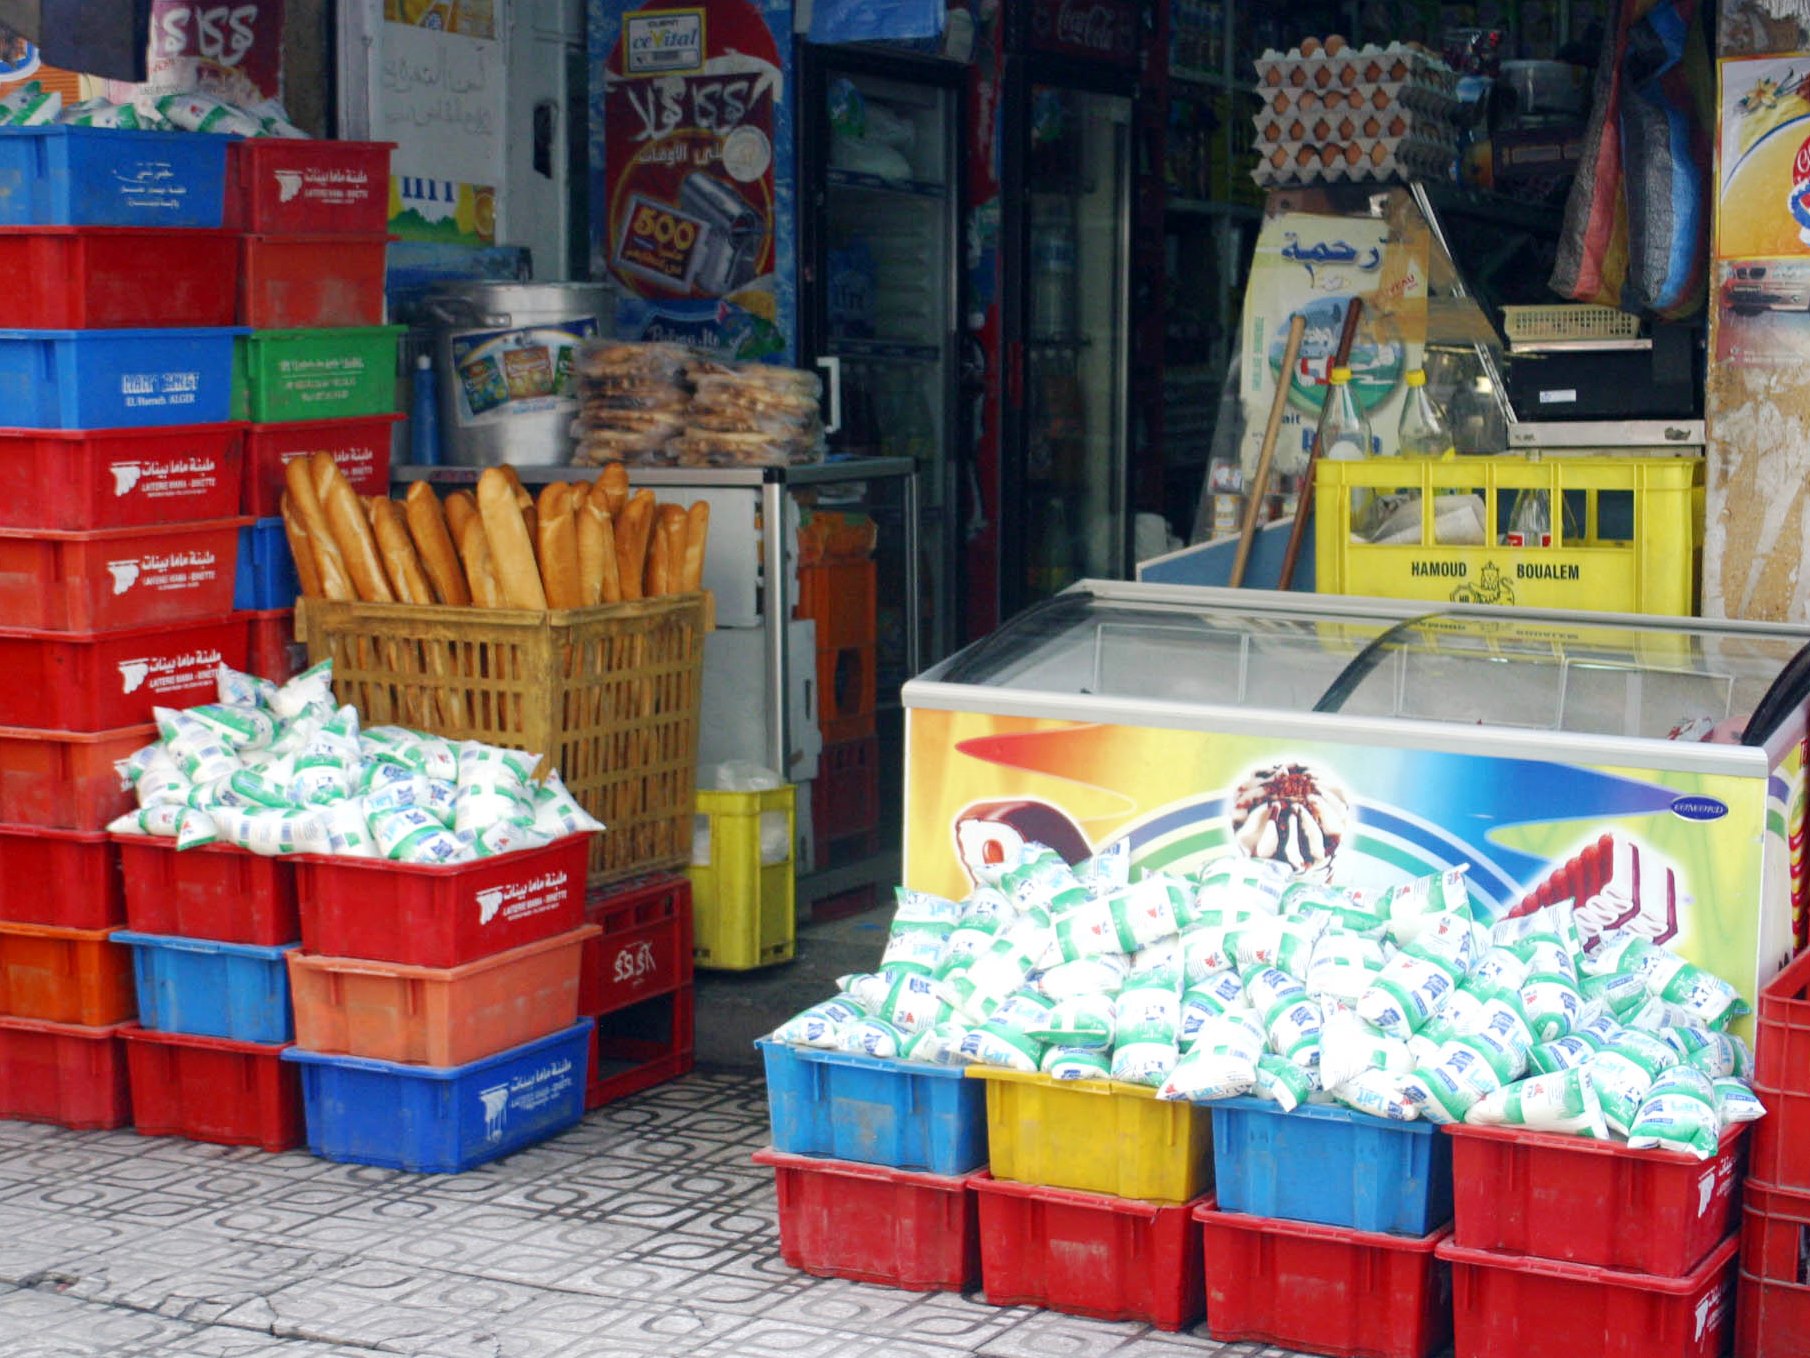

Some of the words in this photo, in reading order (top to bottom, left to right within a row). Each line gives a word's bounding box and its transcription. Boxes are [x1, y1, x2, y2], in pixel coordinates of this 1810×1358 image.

[1280, 413, 1300, 425] ait
[1411, 562, 1467, 577] HAMOUD
[1516, 563, 1580, 580] BOUALEM
